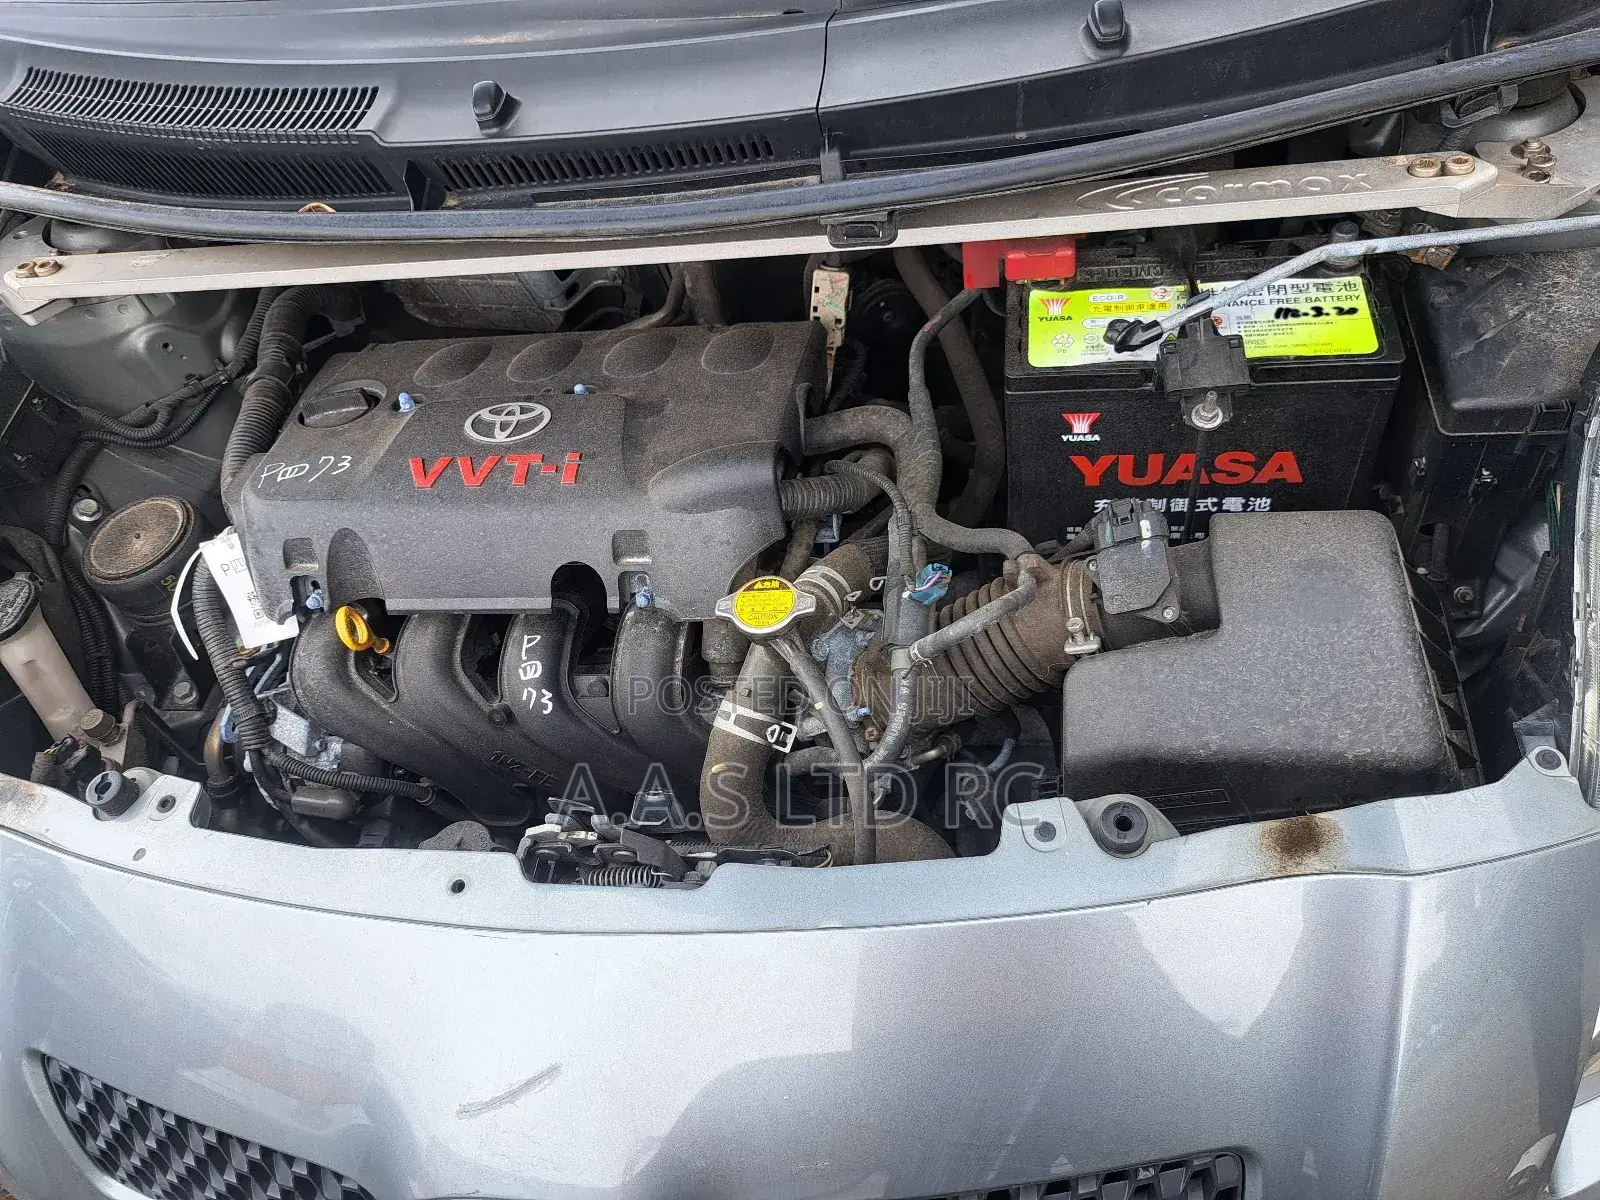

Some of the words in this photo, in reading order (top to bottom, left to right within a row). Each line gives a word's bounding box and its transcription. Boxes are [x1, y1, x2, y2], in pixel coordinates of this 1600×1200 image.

[1269, 297, 1302, 306] FREE
[1304, 294, 1361, 304] BATTERY
[1038, 314, 1073, 322] YUASA
[1060, 434, 1101, 442] YUASA
[409, 452, 582, 489] VVT-i
[1068, 450, 1304, 487] YUASA
